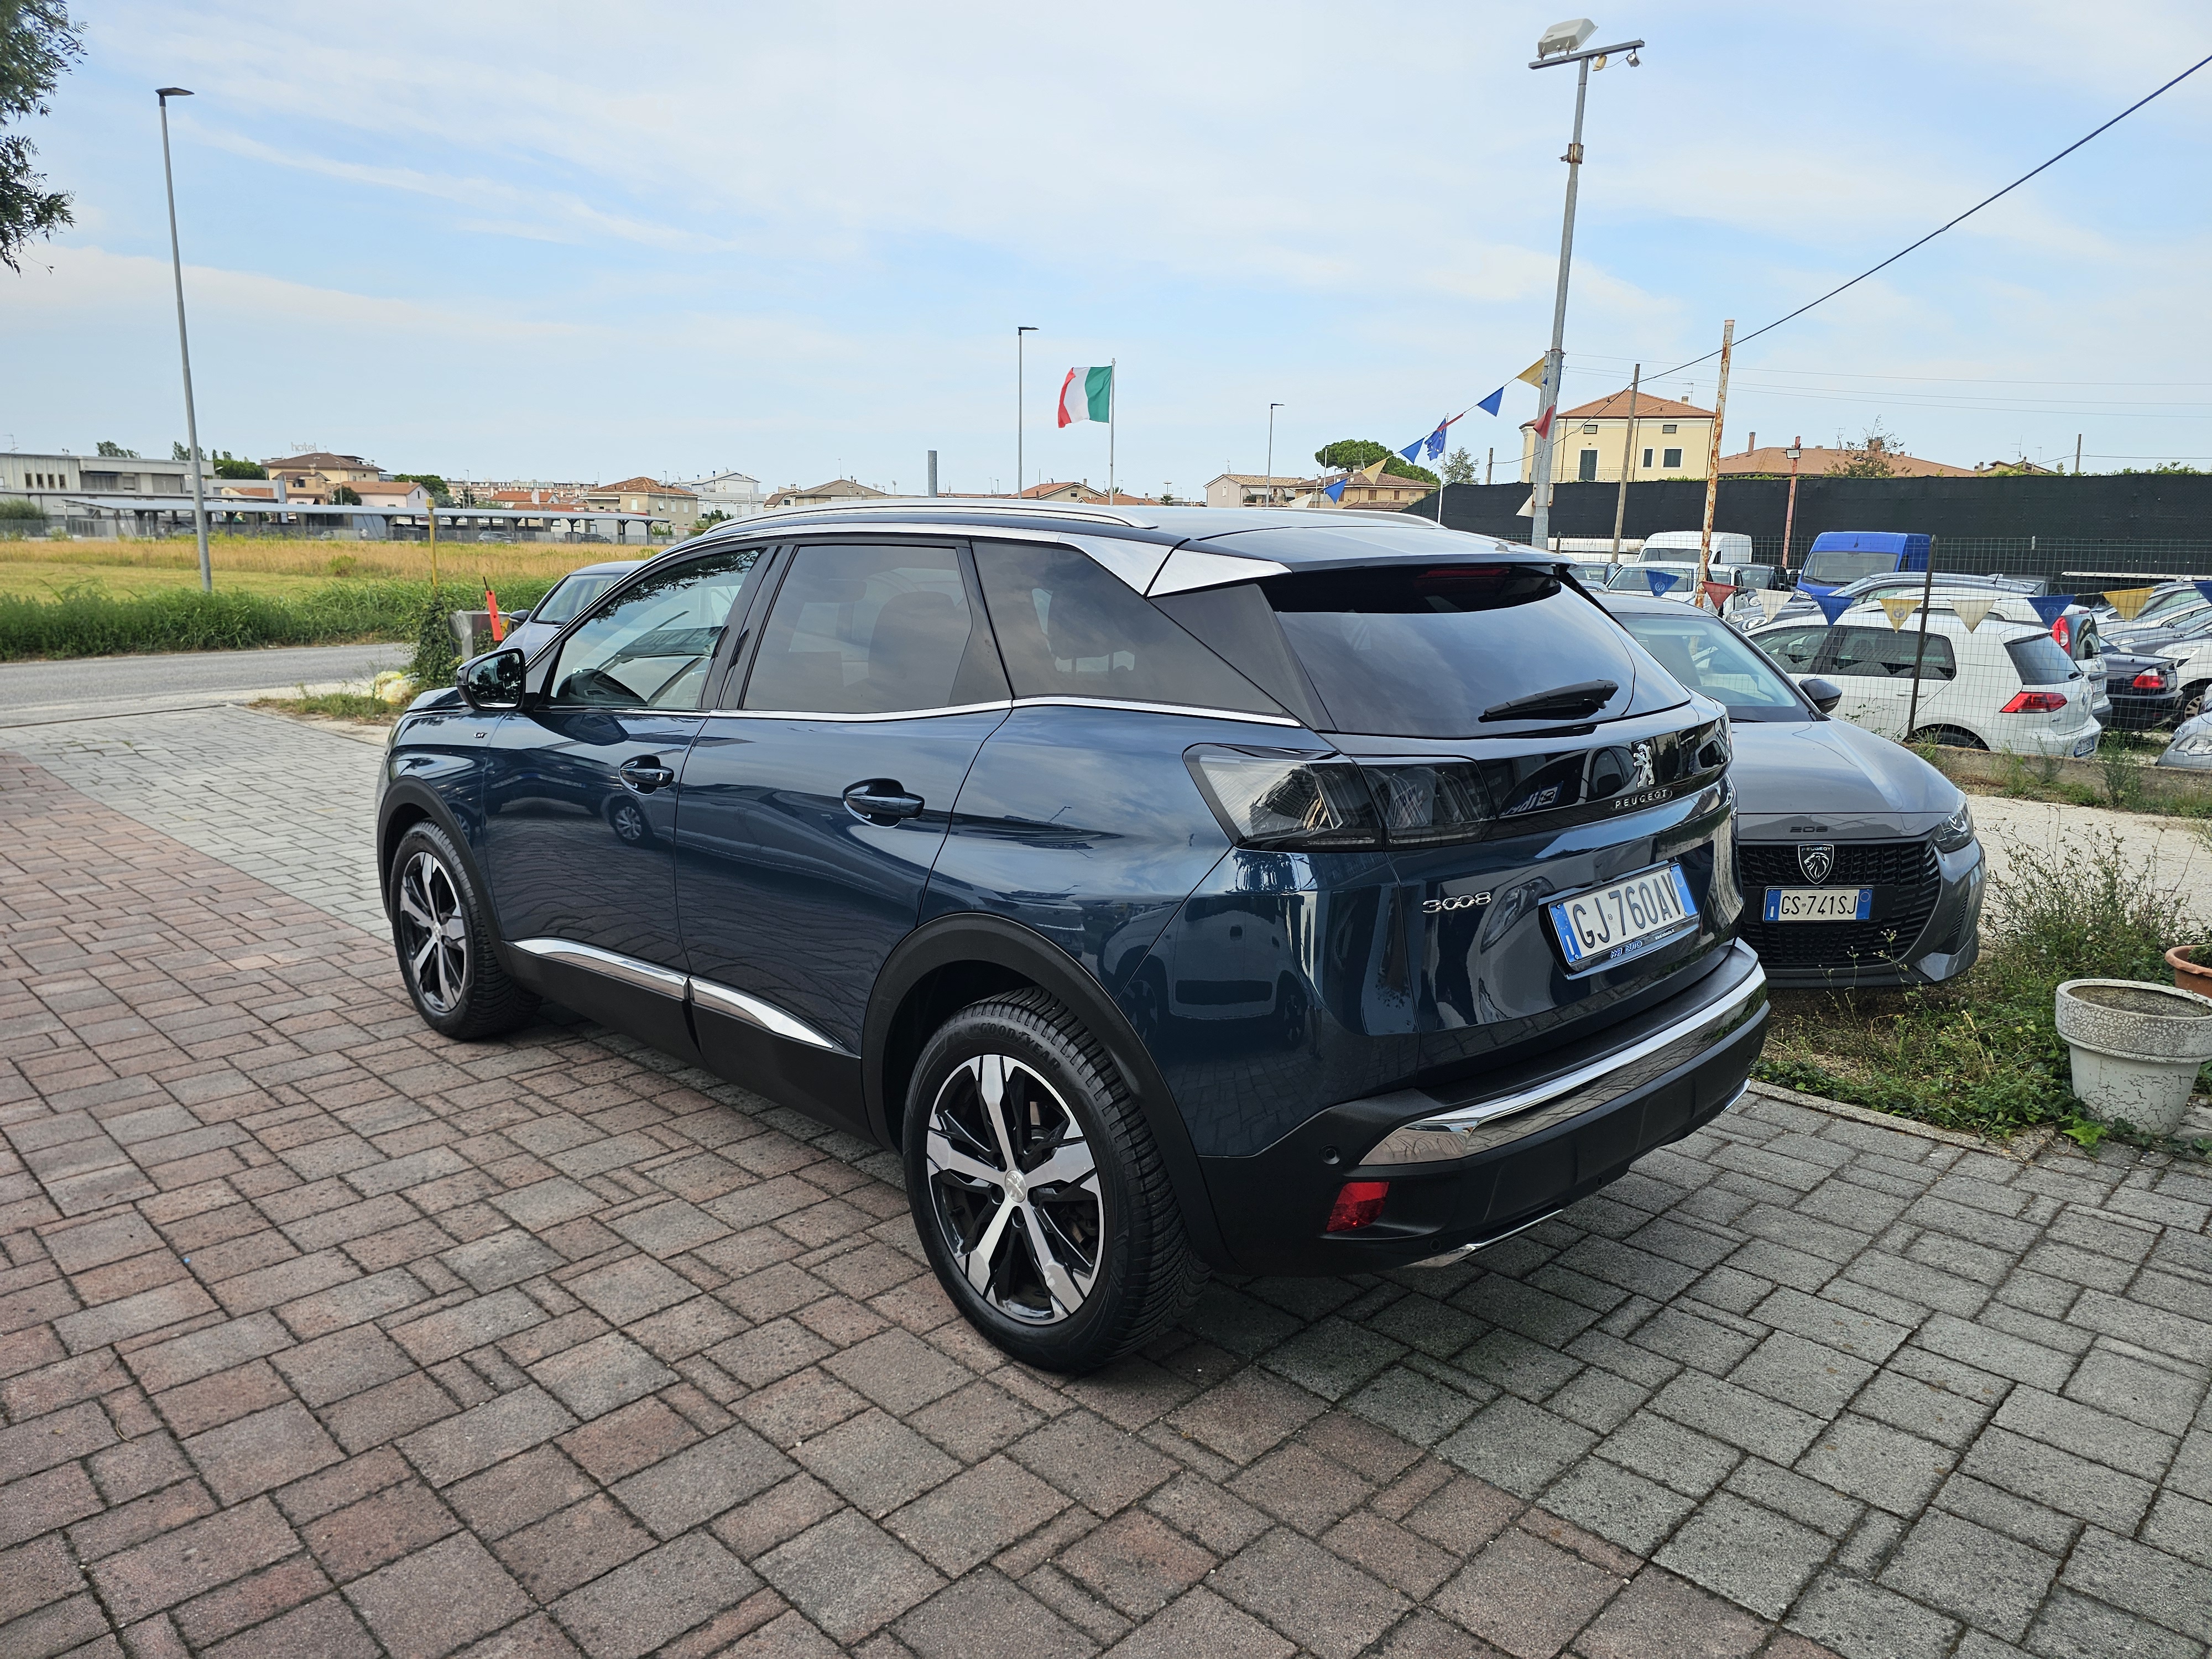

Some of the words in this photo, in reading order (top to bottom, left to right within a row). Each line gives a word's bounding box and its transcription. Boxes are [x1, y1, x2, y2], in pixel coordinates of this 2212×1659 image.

[291, 441, 318, 452] hotel
[1615, 789, 1667, 808] PEUGEOT
[1422, 891, 1491, 914] 3008
[980, 1022, 1061, 1072] GOODYEAR
